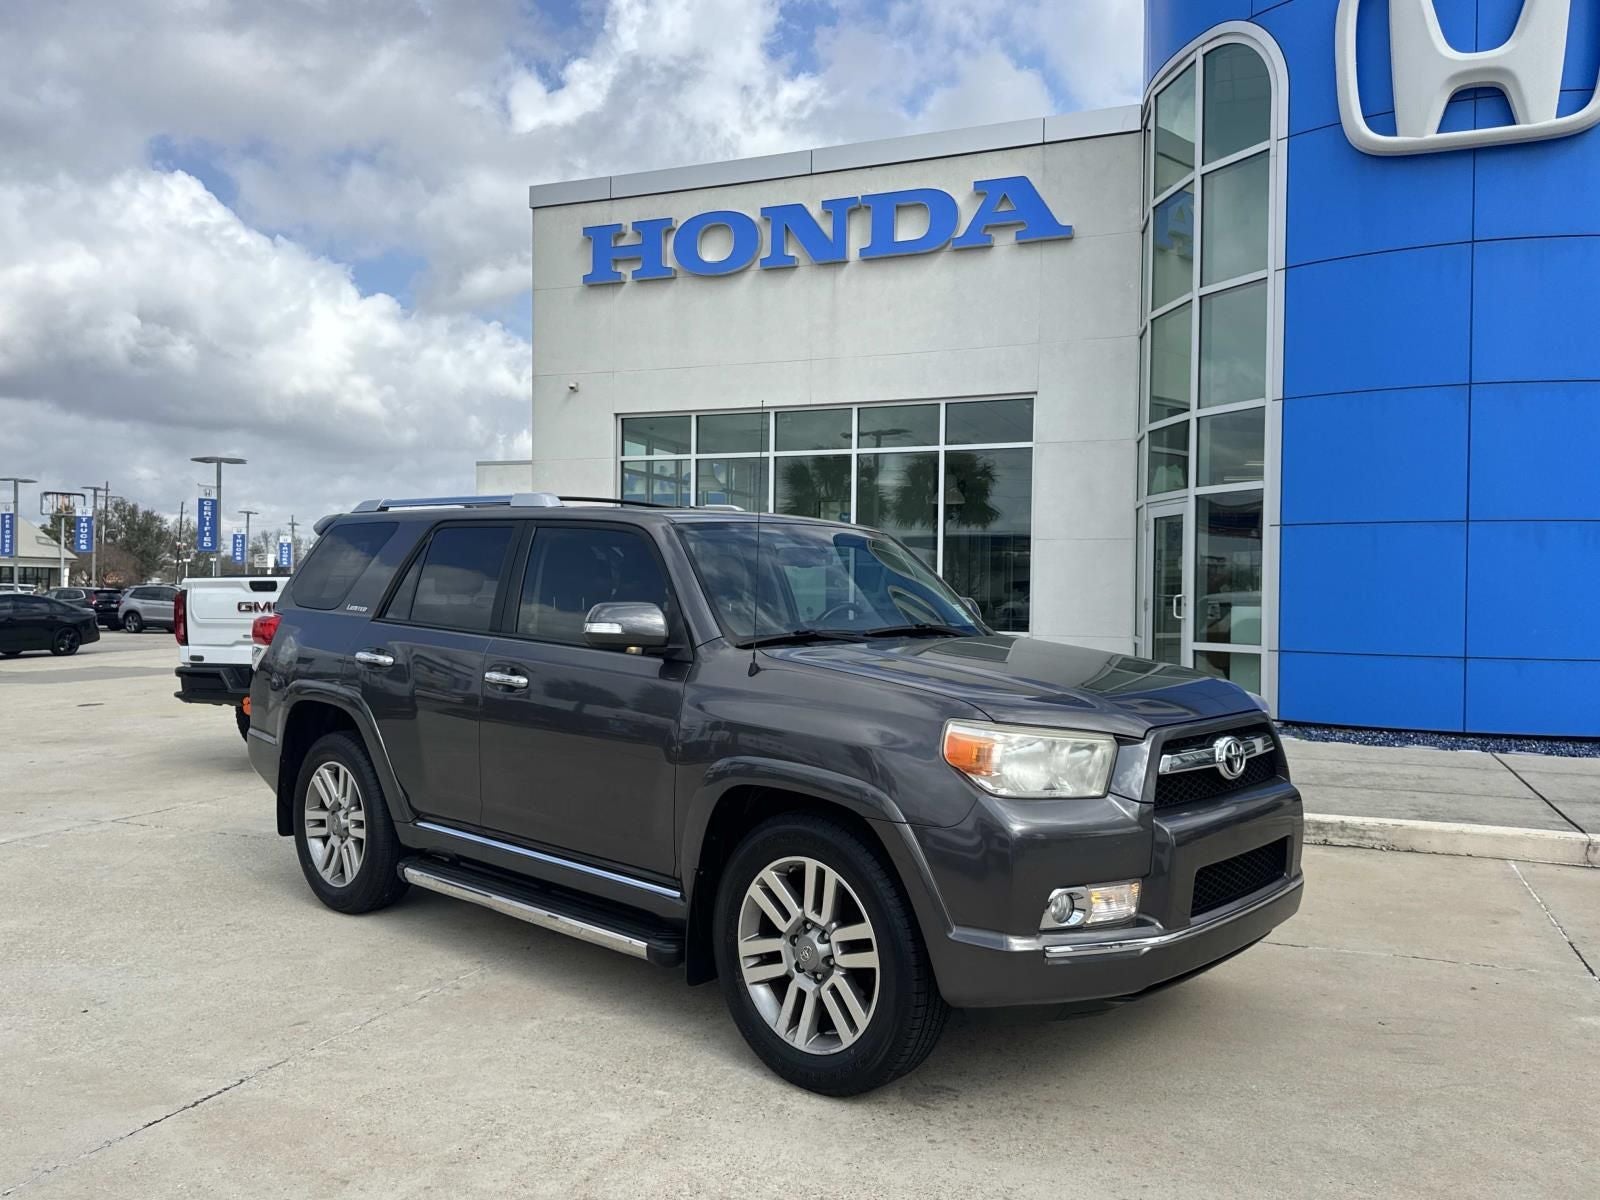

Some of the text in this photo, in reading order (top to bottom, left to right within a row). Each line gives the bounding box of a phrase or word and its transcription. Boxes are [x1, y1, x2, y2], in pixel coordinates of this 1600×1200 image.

[582, 175, 1074, 286] HONDA
[80, 516, 88, 550] TRUCKS
[203, 500, 212, 547] CERTIFIED
